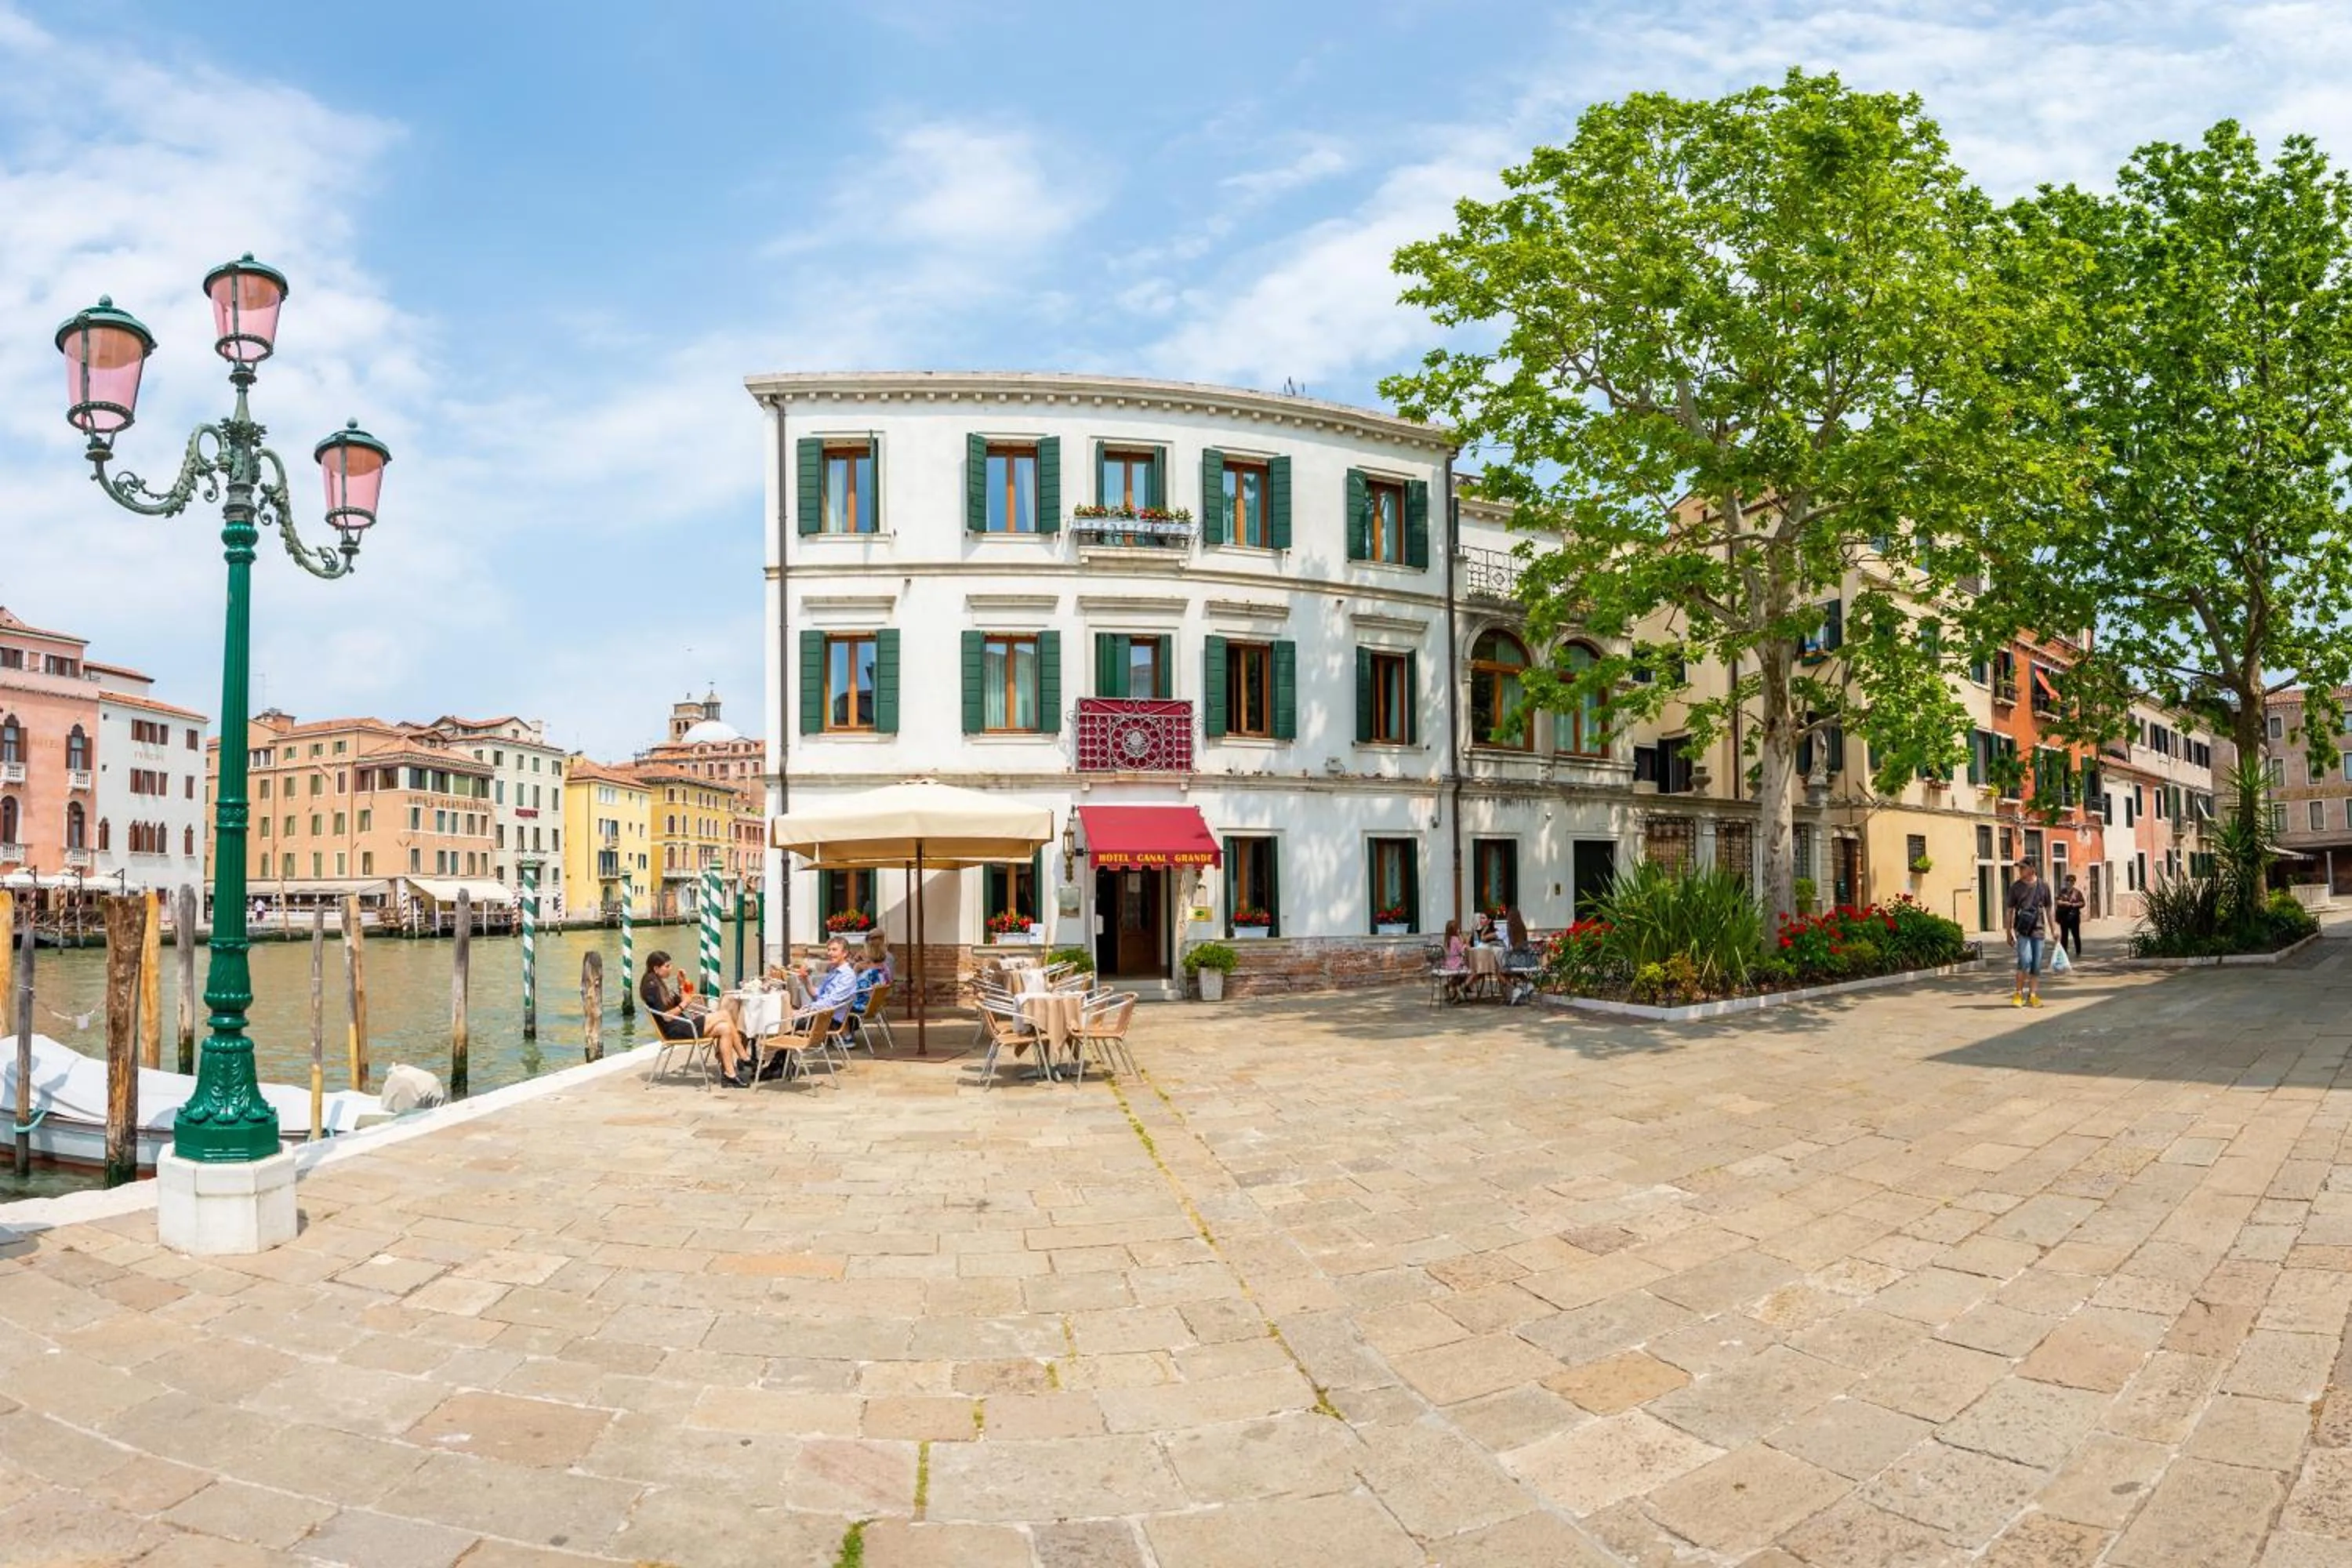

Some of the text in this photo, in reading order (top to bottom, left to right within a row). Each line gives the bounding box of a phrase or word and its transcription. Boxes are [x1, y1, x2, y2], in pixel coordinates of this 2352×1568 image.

[1098, 853, 1213, 862] HOTEL CANAL GRANDE
